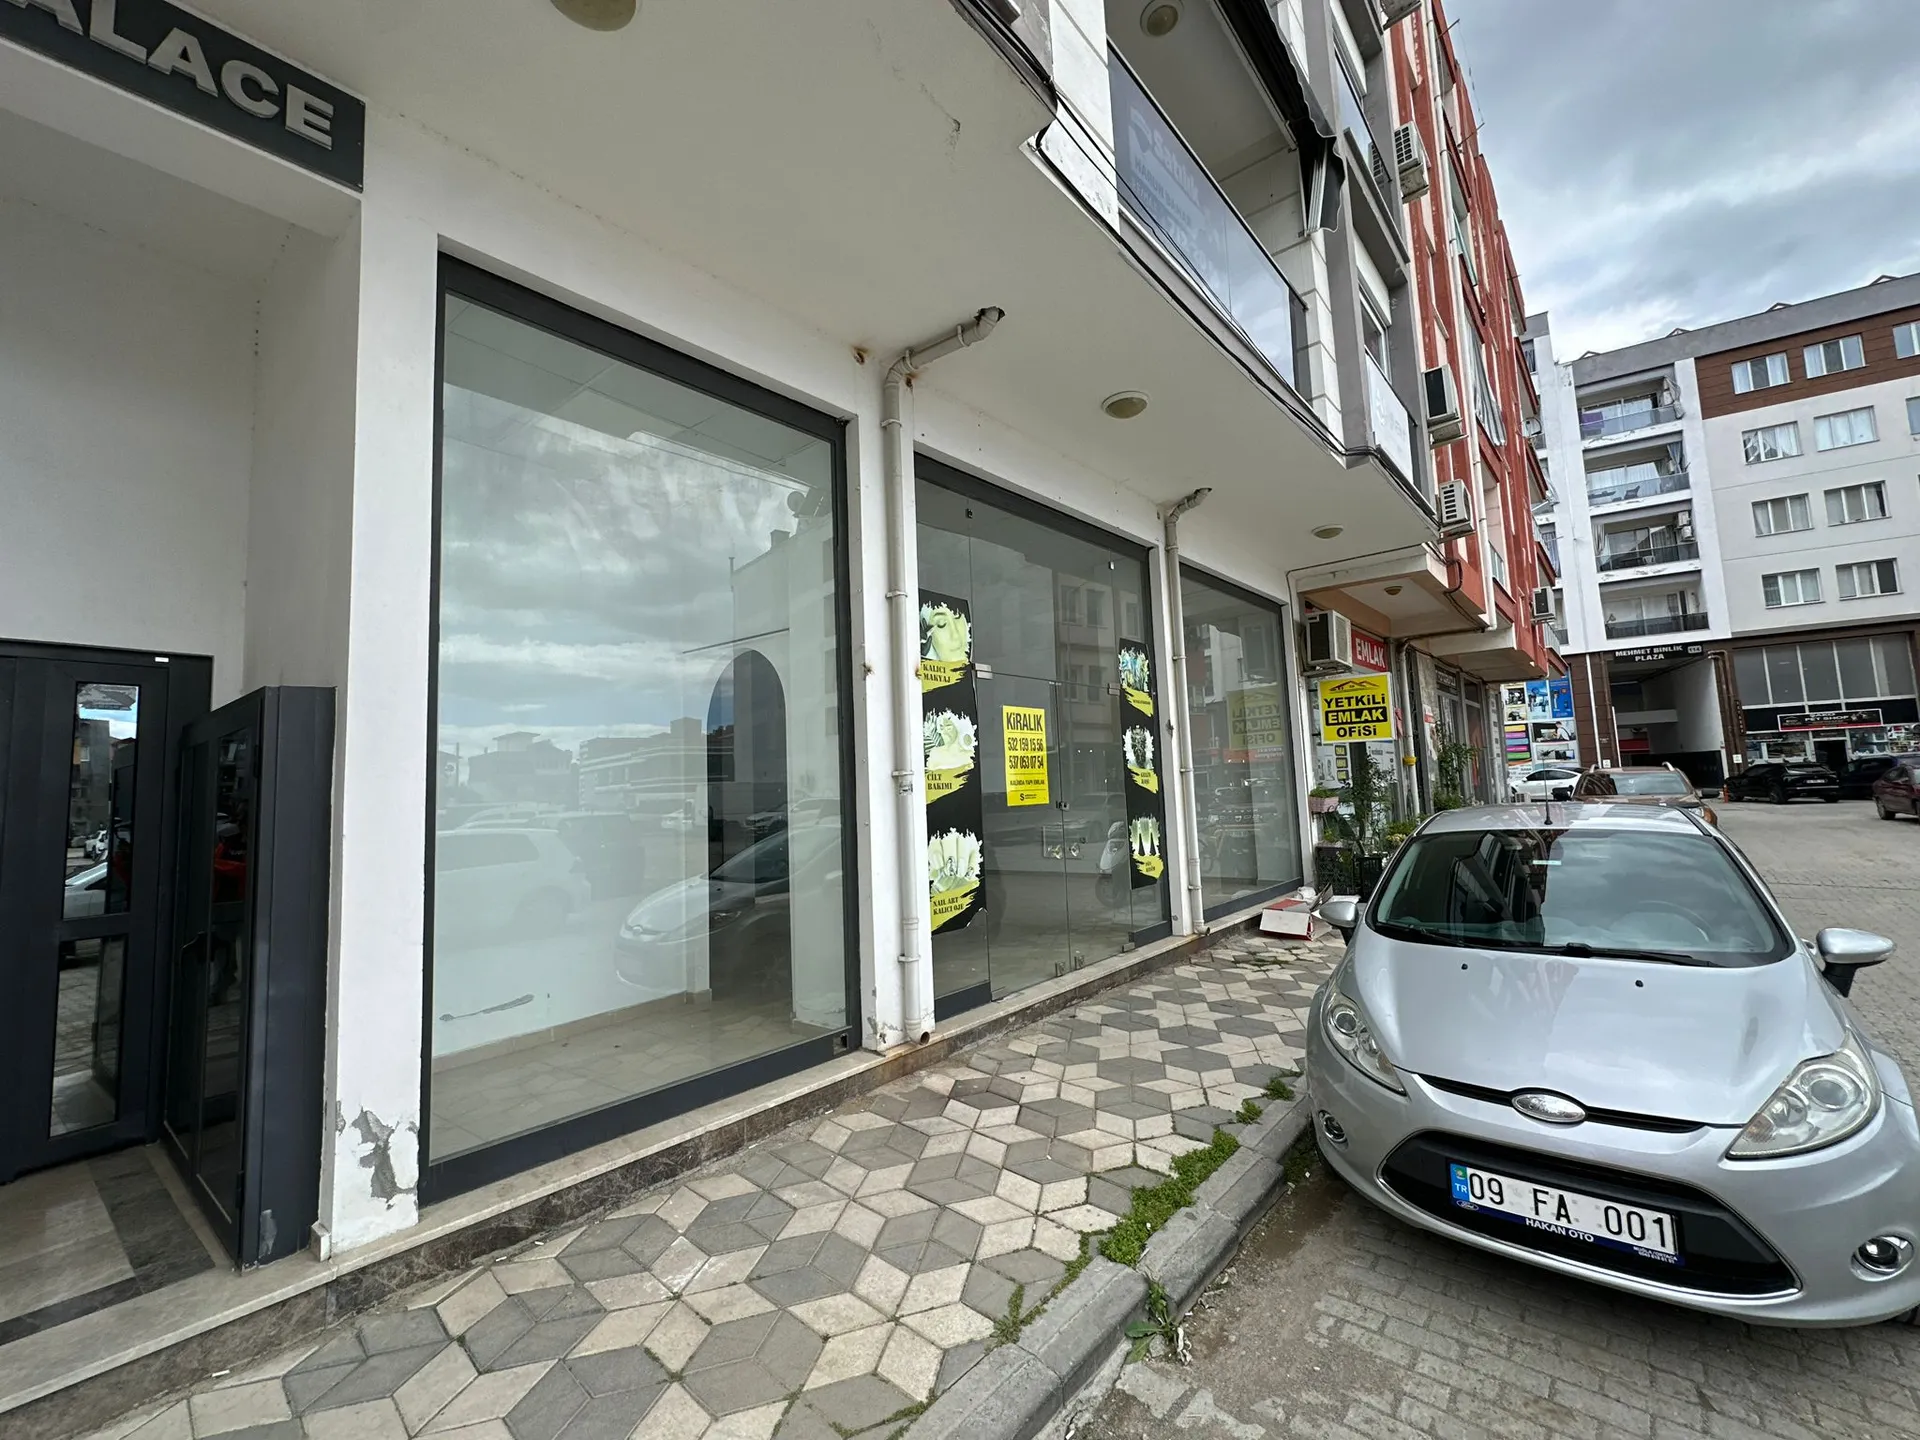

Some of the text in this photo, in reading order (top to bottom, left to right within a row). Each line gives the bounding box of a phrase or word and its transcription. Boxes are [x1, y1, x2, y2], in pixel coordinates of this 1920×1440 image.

[1355, 638, 1385, 668] EMLAK
[1615, 648, 1651, 657] MEHMET
[1635, 653, 1665, 662] PLAZA
[923, 664, 946, 674] KALICI
[923, 673, 951, 684] MAKYAJ
[1327, 708, 1385, 724] EMLAK
[1008, 737, 1018, 752] 532
[1009, 755, 1019, 769] 537
[927, 772, 942, 782] CİLT
[927, 782, 953, 791] BAKIMI
[947, 897, 959, 905] ART
[1455, 1173, 1666, 1248] TR 09 FA 001
[1525, 1217, 1595, 1243] HAKAN OTO
